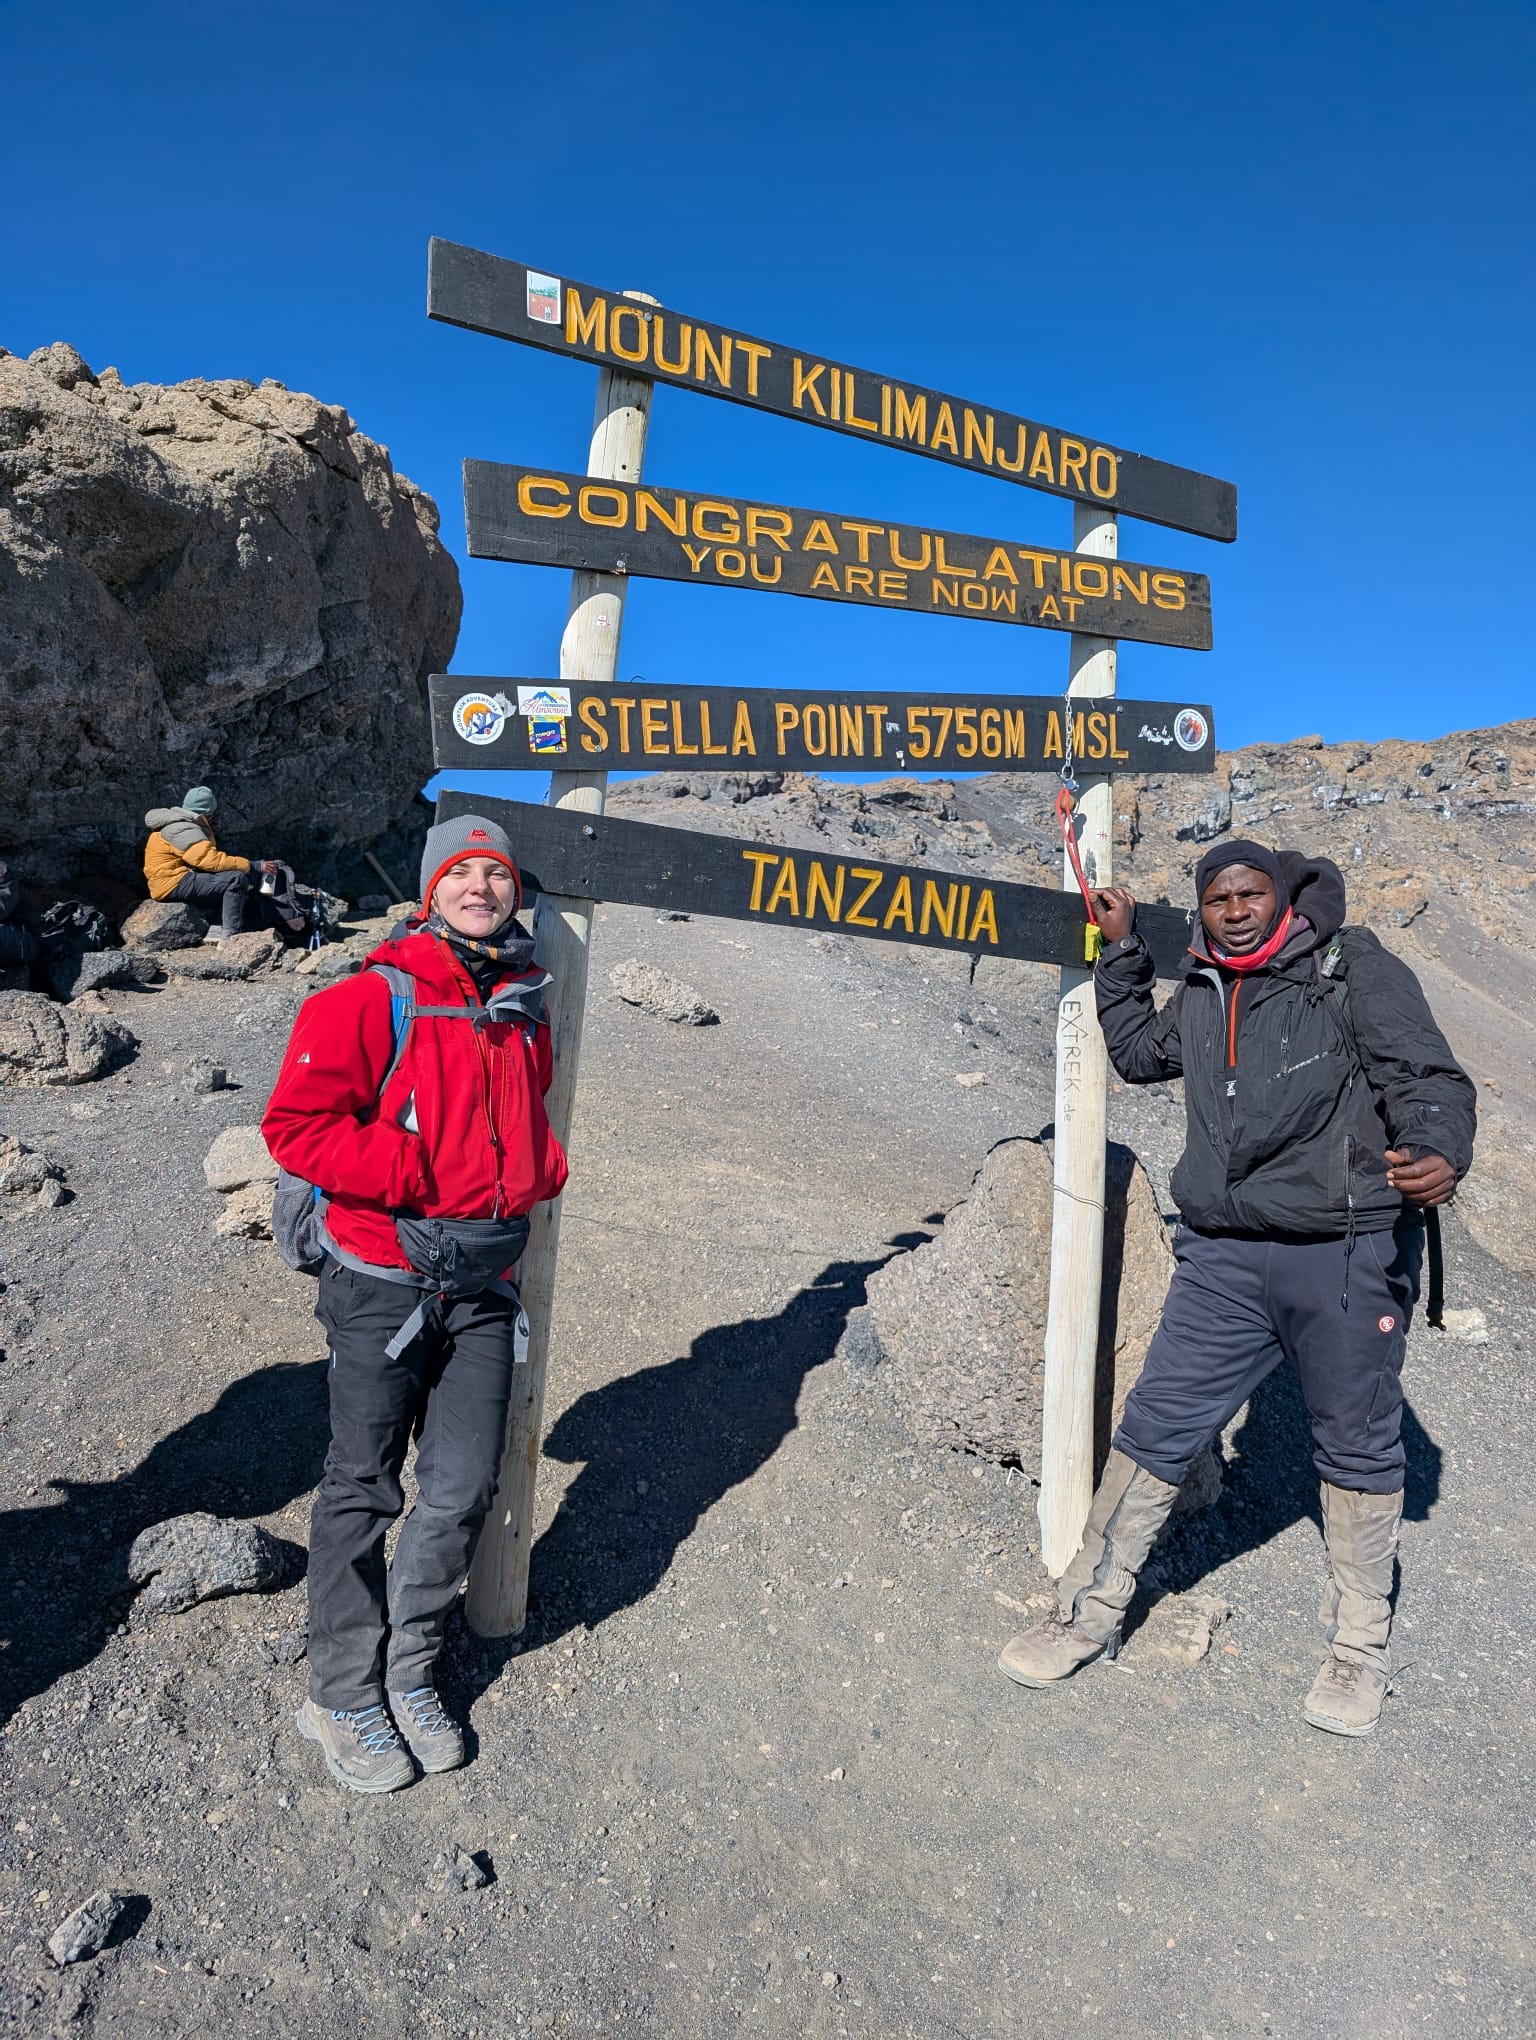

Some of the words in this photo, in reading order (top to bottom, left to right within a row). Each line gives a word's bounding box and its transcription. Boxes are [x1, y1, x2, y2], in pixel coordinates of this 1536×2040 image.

[565, 287, 772, 397] MOUNT
[792, 357, 1118, 499] KILIMANJARO
[517, 475, 1186, 611] CONGRATULATIONS
[682, 544, 783, 584] YOU
[810, 562, 908, 600] ARE
[932, 577, 1017, 614] NOW
[1039, 593, 1085, 622] AT
[577, 696, 757, 756] STELLA
[775, 703, 888, 757] POINT
[907, 706, 1026, 759] 5756M
[1043, 710, 1130, 759] AMSL
[742, 850, 999, 945] TANZANIA
